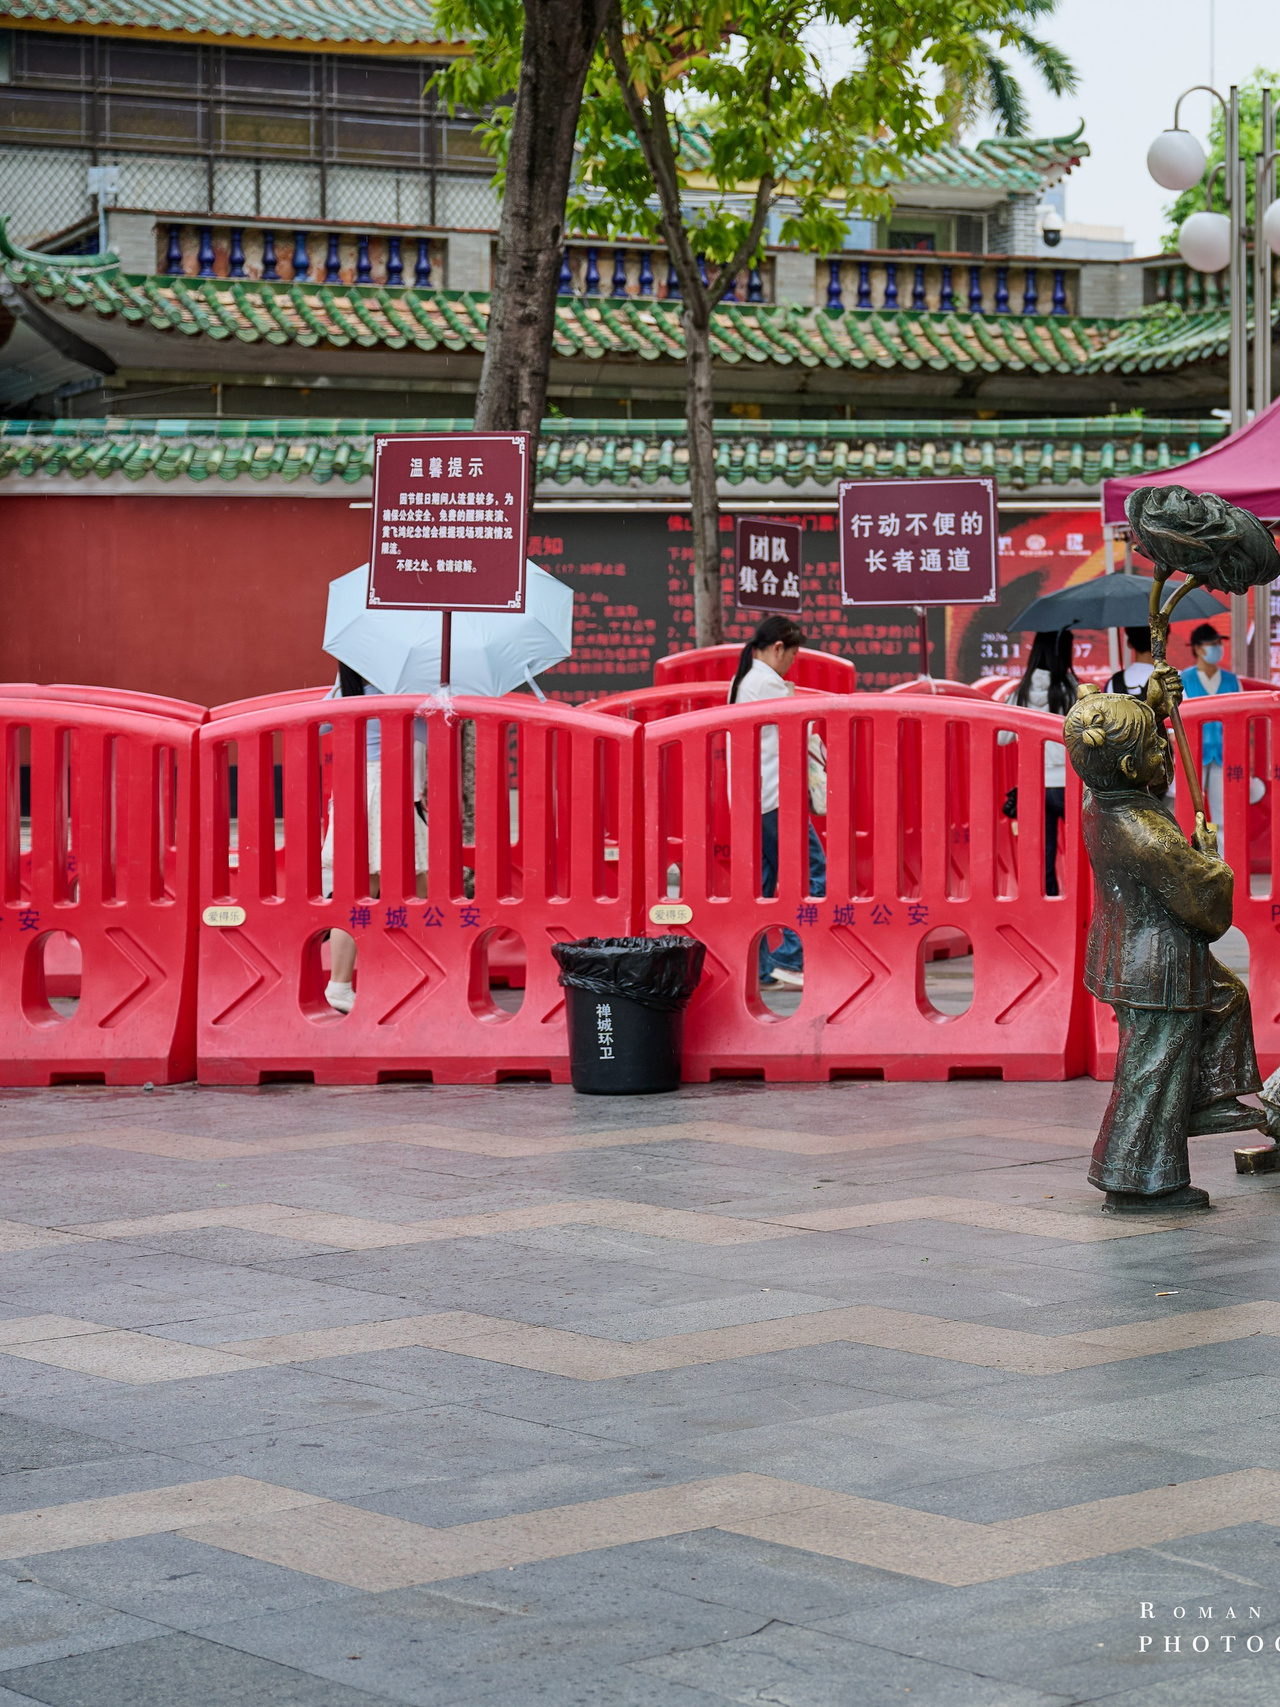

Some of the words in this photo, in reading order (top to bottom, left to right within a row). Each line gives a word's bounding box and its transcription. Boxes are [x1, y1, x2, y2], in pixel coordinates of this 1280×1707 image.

[410, 457, 484, 478] 温馨提示
[851, 511, 983, 538] 行动不便的
[749, 534, 790, 563] 团队
[865, 547, 971, 573] 长者通道
[739, 565, 800, 598] 集合点
[208, 910, 241, 923] 爱得乐
[349, 906, 481, 929] 禅城公安
[655, 908, 687, 921] 爱得乐
[796, 903, 930, 927] 禅城公安
[596, 1003, 615, 1060] 禅城环卫
